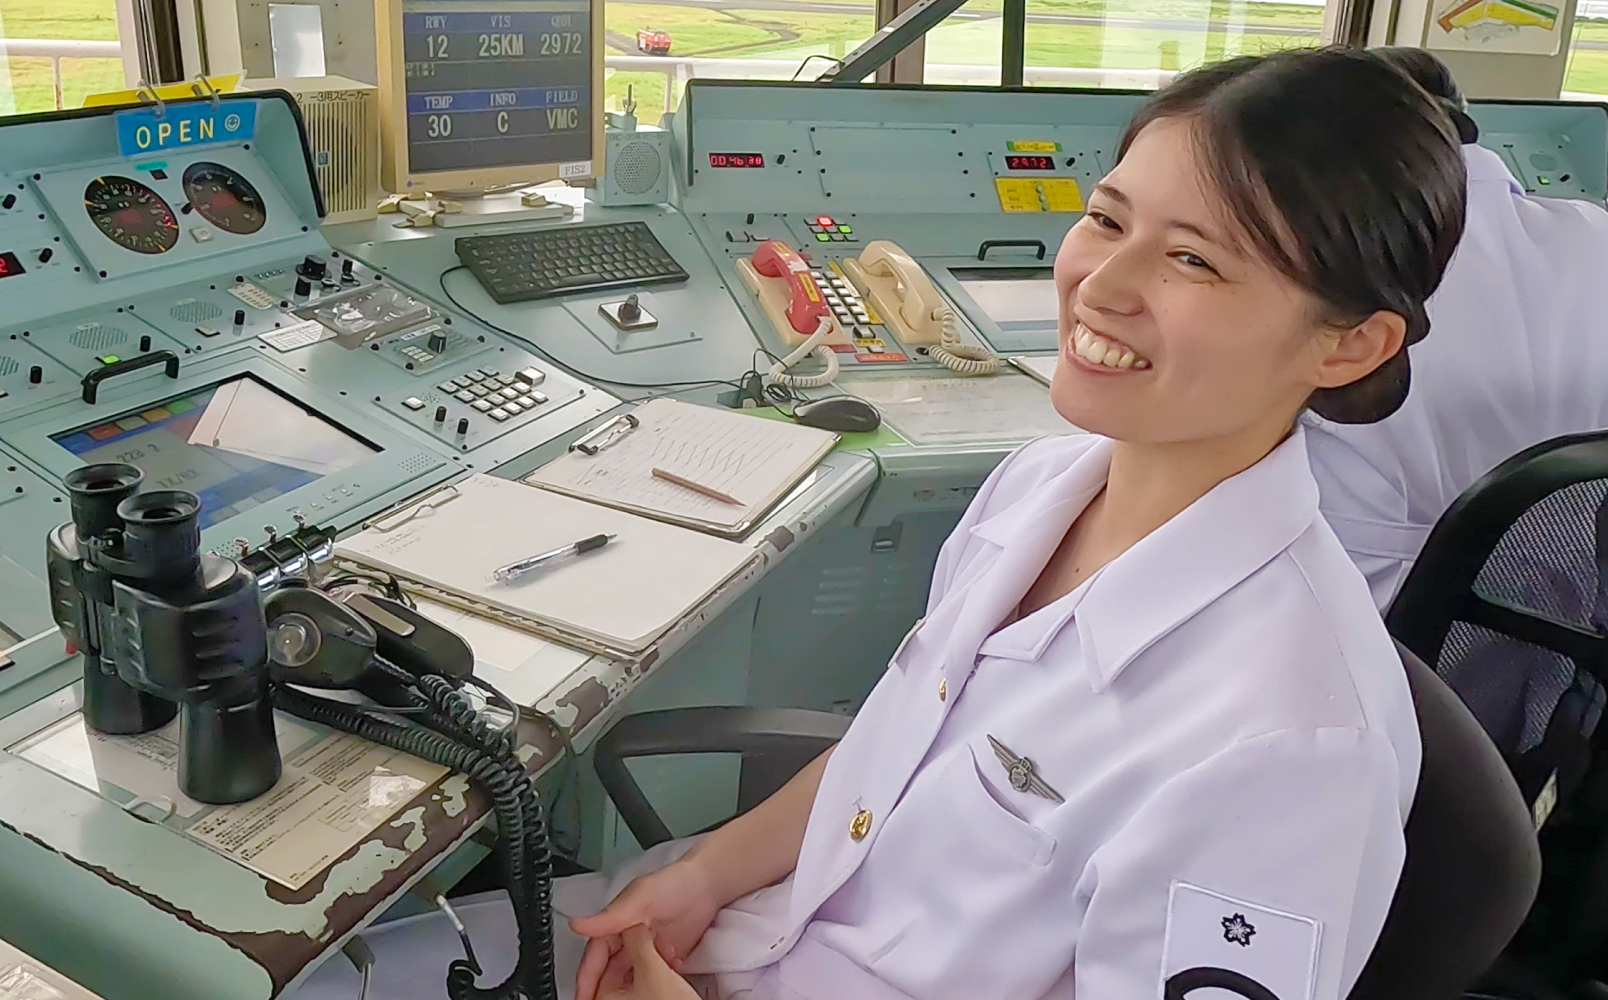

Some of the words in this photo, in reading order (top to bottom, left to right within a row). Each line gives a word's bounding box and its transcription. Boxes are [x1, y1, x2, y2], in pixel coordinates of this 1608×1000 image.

[425, 15, 447, 29] RWY
[490, 15, 511, 28] VIS
[426, 34, 449, 58] 12
[478, 33, 524, 57] 25KM
[541, 33, 582, 55] 2972
[424, 95, 453, 110] TEMP
[490, 93, 516, 107] INFO
[546, 90, 578, 104] FIELD
[136, 117, 214, 149] OPEN
[428, 114, 452, 138] 30
[497, 111, 509, 133] C
[546, 108, 578, 130] VMC
[564, 163, 587, 176] FIS2
[1011, 157, 1047, 168] 2972
